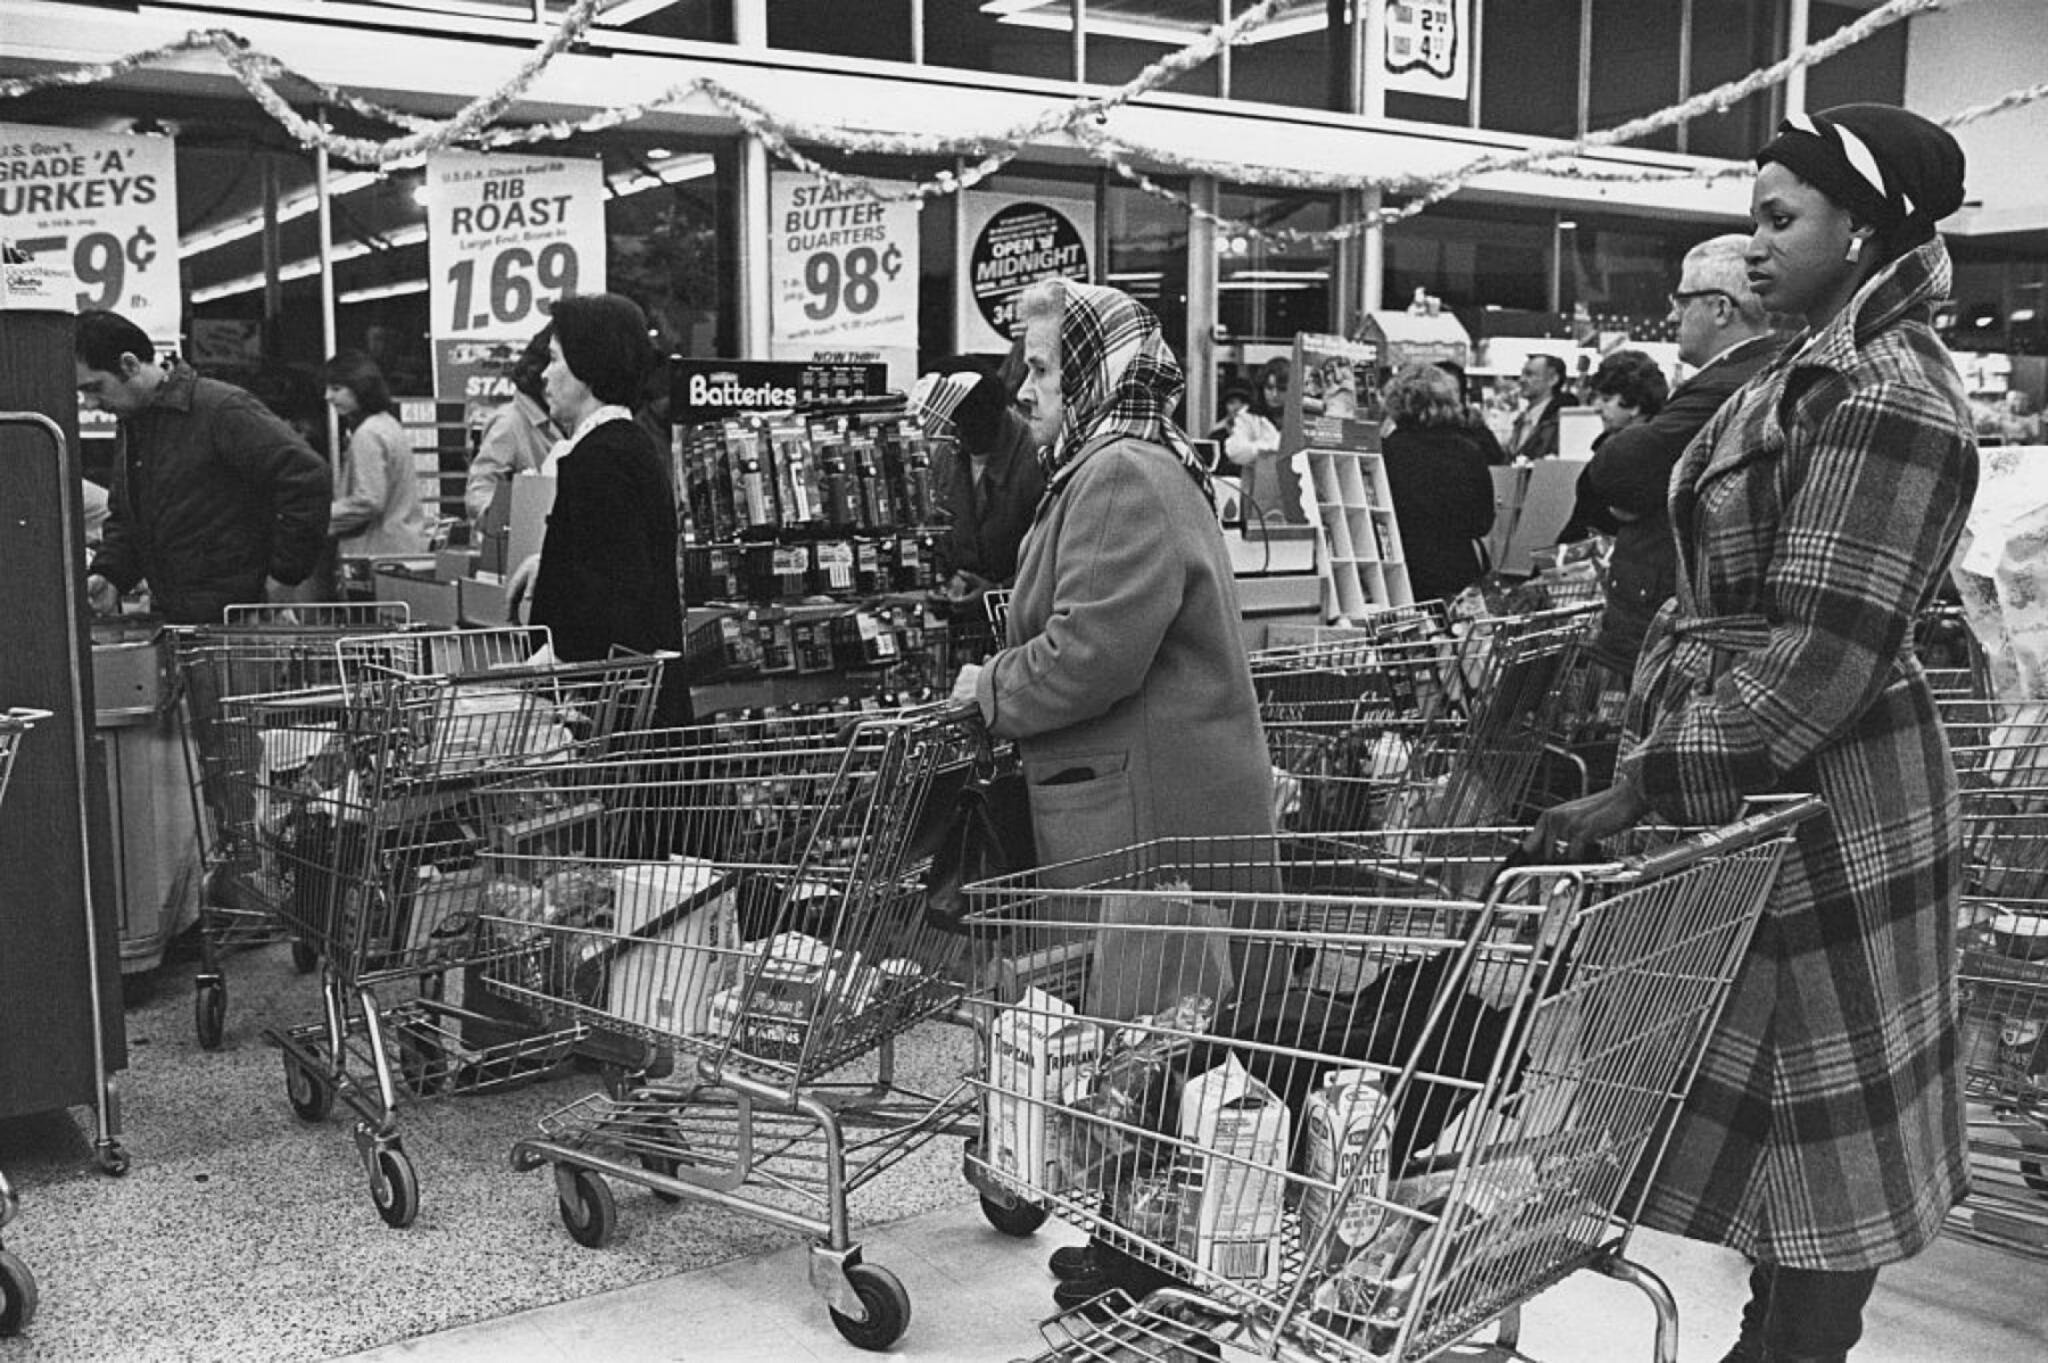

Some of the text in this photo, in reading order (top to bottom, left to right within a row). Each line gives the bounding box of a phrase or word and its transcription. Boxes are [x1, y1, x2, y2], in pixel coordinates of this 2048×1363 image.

[482, 178, 524, 202] RIB
[451, 194, 573, 236] ROAST
[785, 202, 881, 234] BUTTER
[787, 224, 885, 254] QUARTERS
[992, 238, 1034, 259] OPEN
[977, 243, 1080, 281] MIDNIGHT
[447, 242, 579, 332] 1.69
[803, 241, 902, 321] 98¢
[465, 375, 516, 398] STA
[690, 374, 797, 407] Batteries
